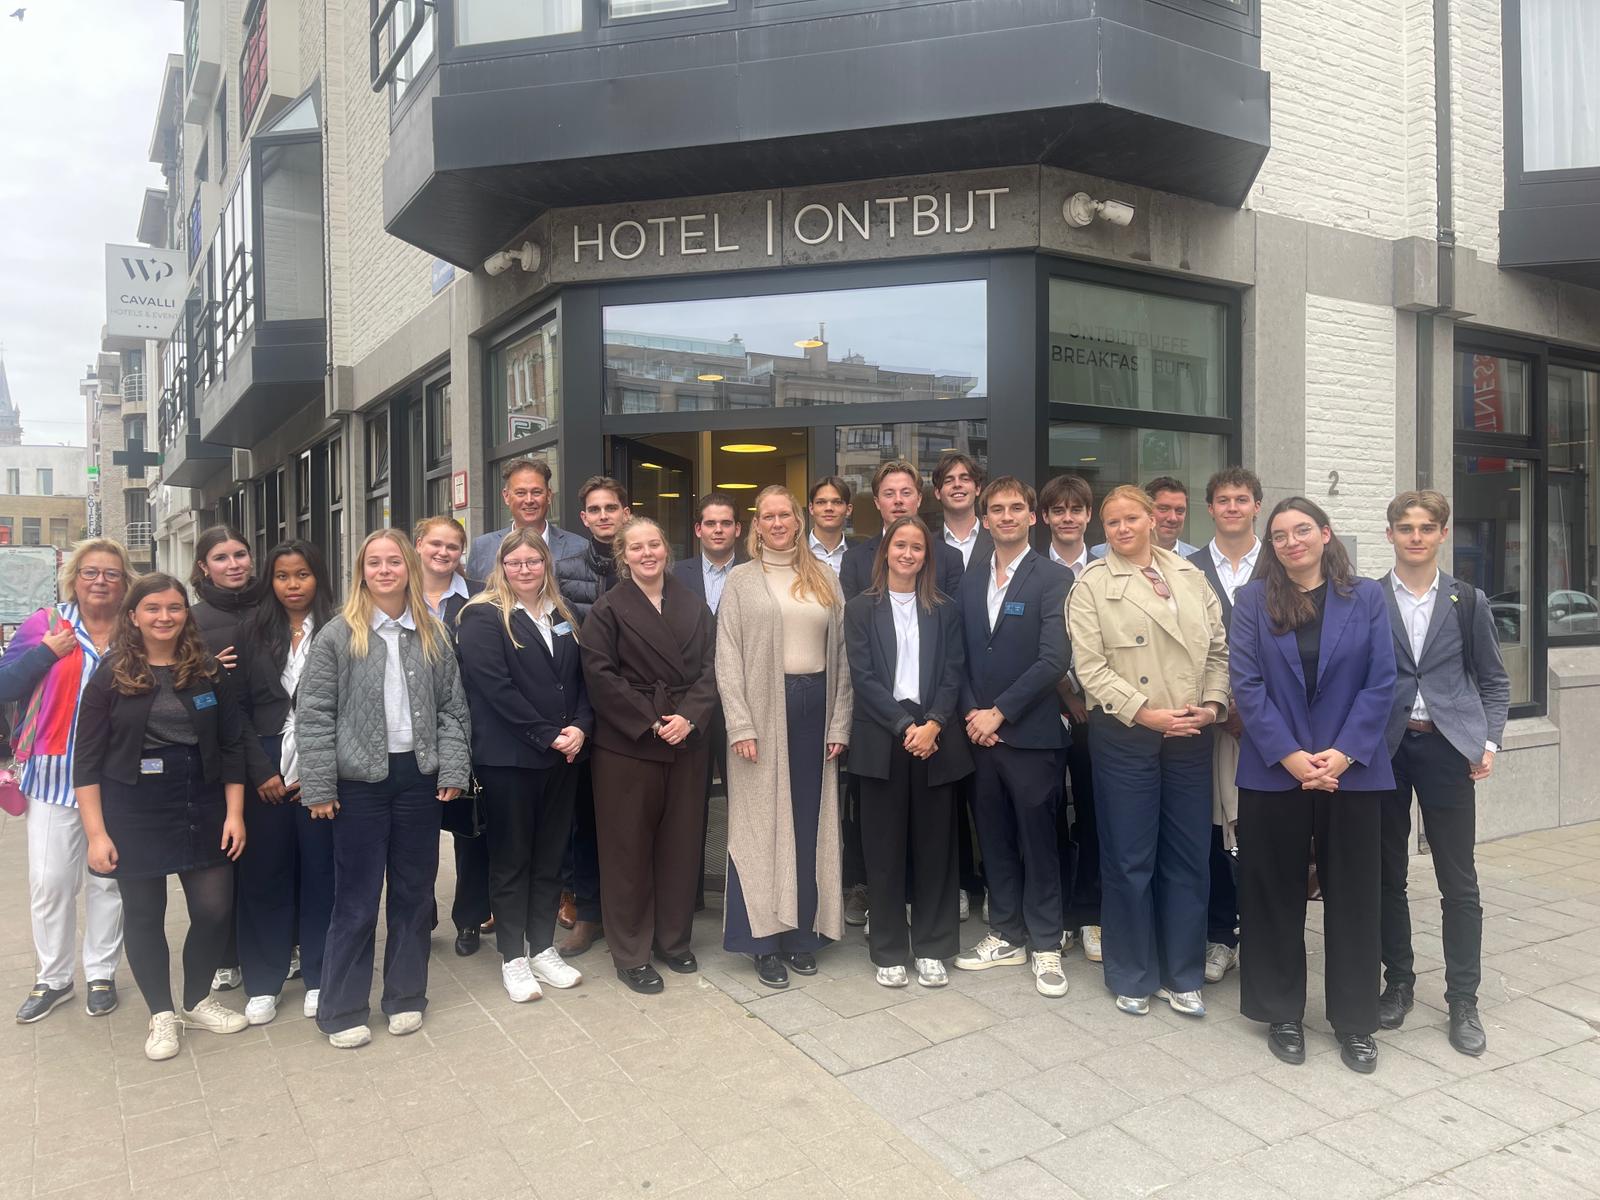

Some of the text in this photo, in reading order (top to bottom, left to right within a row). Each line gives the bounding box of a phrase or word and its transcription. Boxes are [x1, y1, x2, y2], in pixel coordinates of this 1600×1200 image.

[573, 213, 739, 263] HOTEL
[794, 187, 1009, 245] ONTBIJT
[120, 294, 175, 308] CAVALLI
[1328, 470, 1340, 496] 2
